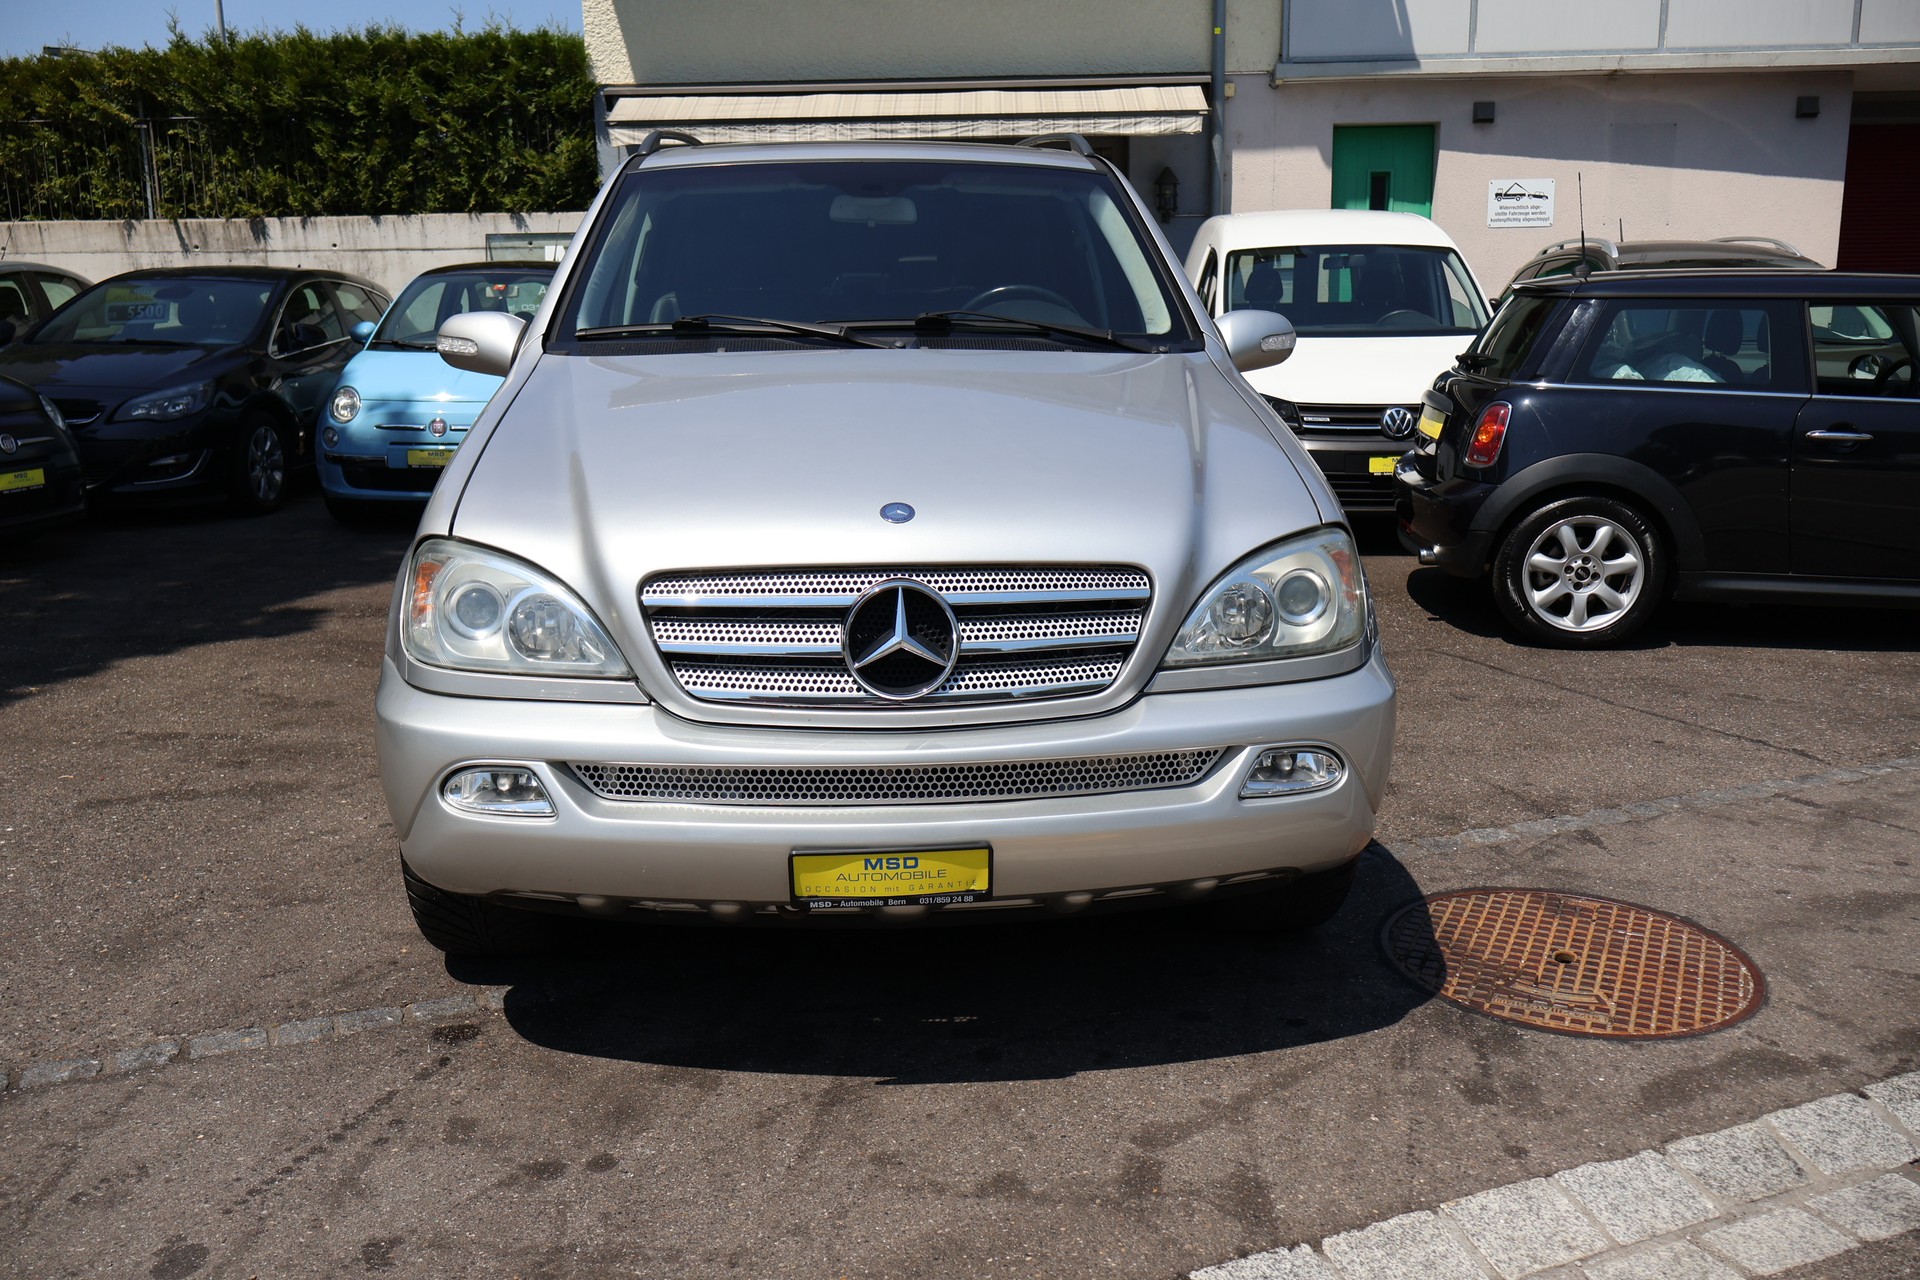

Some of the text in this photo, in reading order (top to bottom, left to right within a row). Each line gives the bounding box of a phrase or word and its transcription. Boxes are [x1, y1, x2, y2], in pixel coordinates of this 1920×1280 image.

[128, 304, 164, 318] 5500
[864, 857, 919, 870] MSD
[836, 868, 947, 882] AUTOMOBILE
[805, 885, 877, 893] OCCASION
[908, 879, 977, 891] GARANTIE
[919, 896, 951, 905] 031/859
